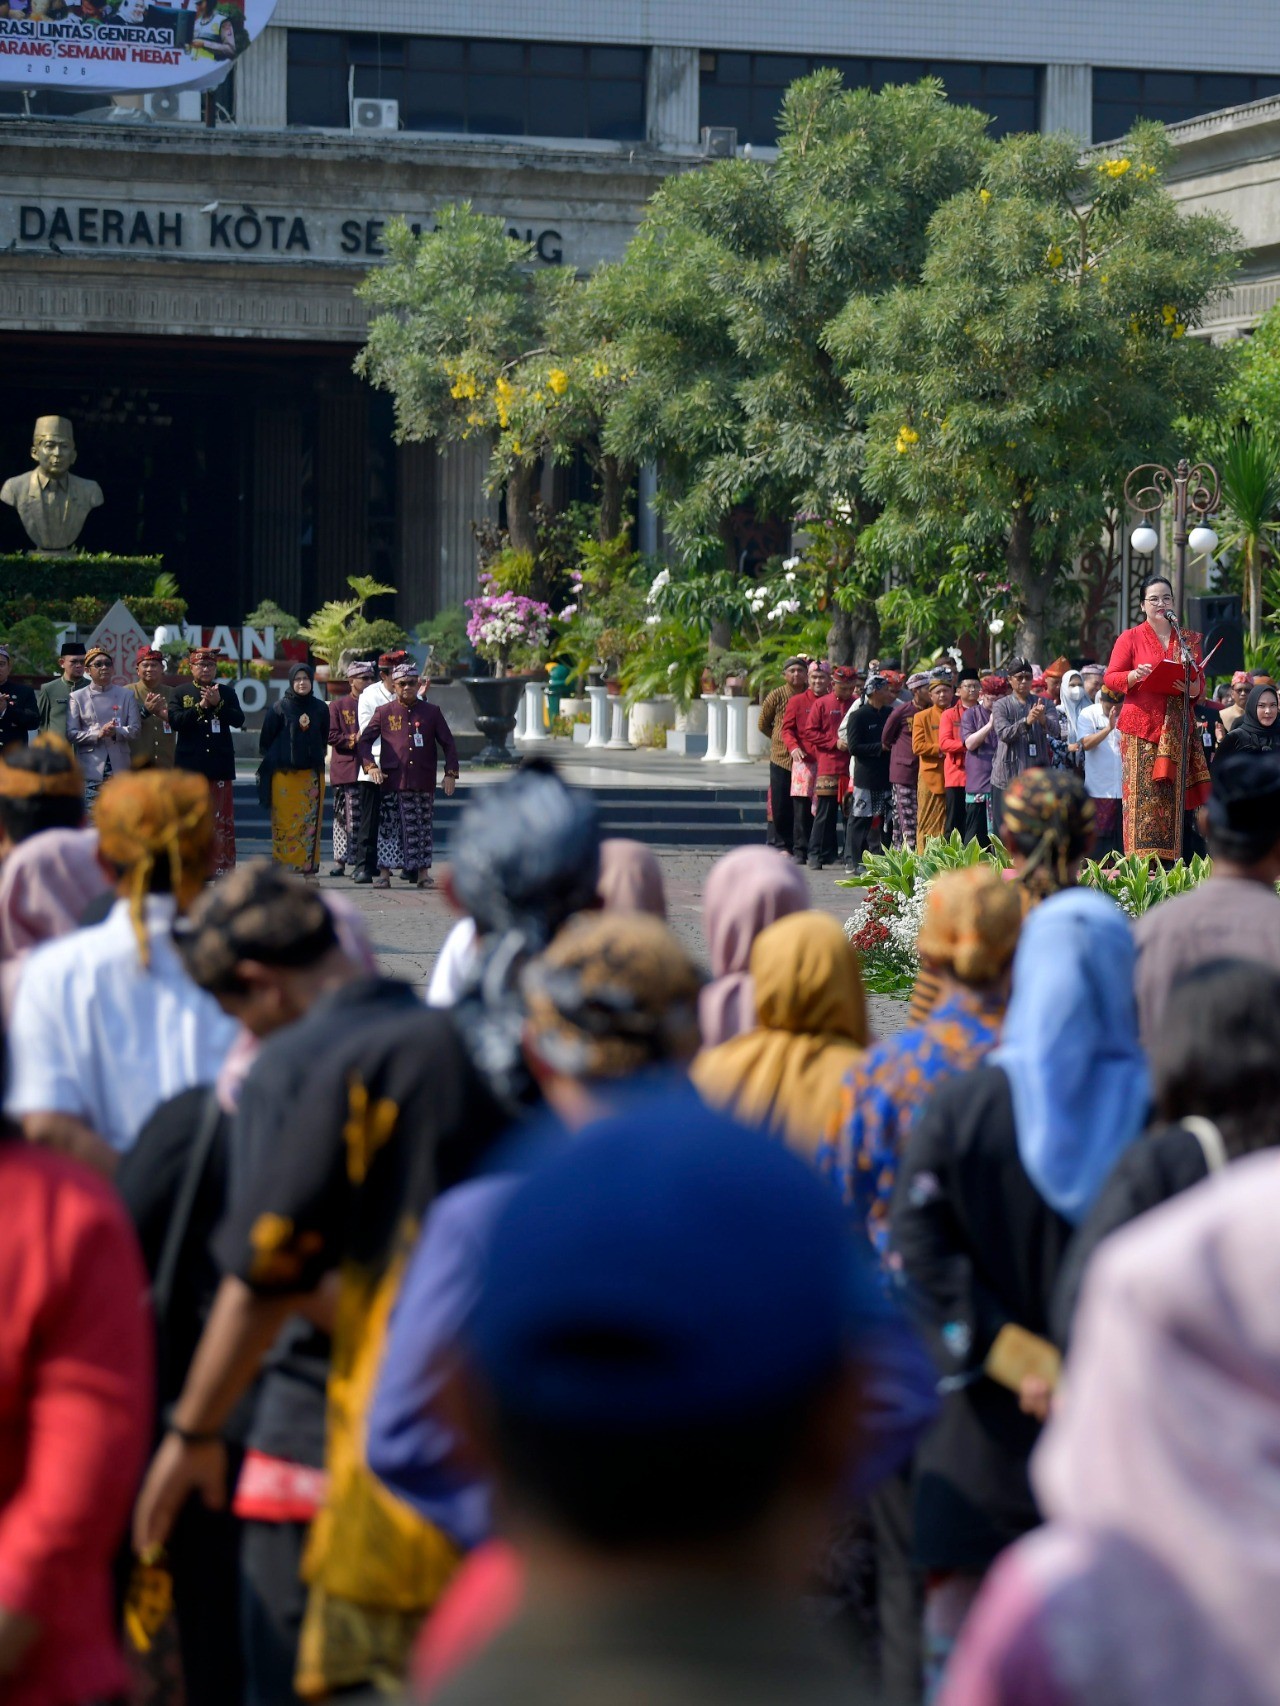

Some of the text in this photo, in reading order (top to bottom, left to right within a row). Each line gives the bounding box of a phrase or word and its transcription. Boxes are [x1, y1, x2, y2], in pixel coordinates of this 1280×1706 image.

[40, 22, 93, 39] LINTAS
[98, 26, 172, 45] GENERASI
[57, 44, 126, 62] SEMAKIN
[132, 49, 181, 65] HEBAT
[19, 205, 183, 247] DAERAH
[210, 213, 311, 251] KOTA
